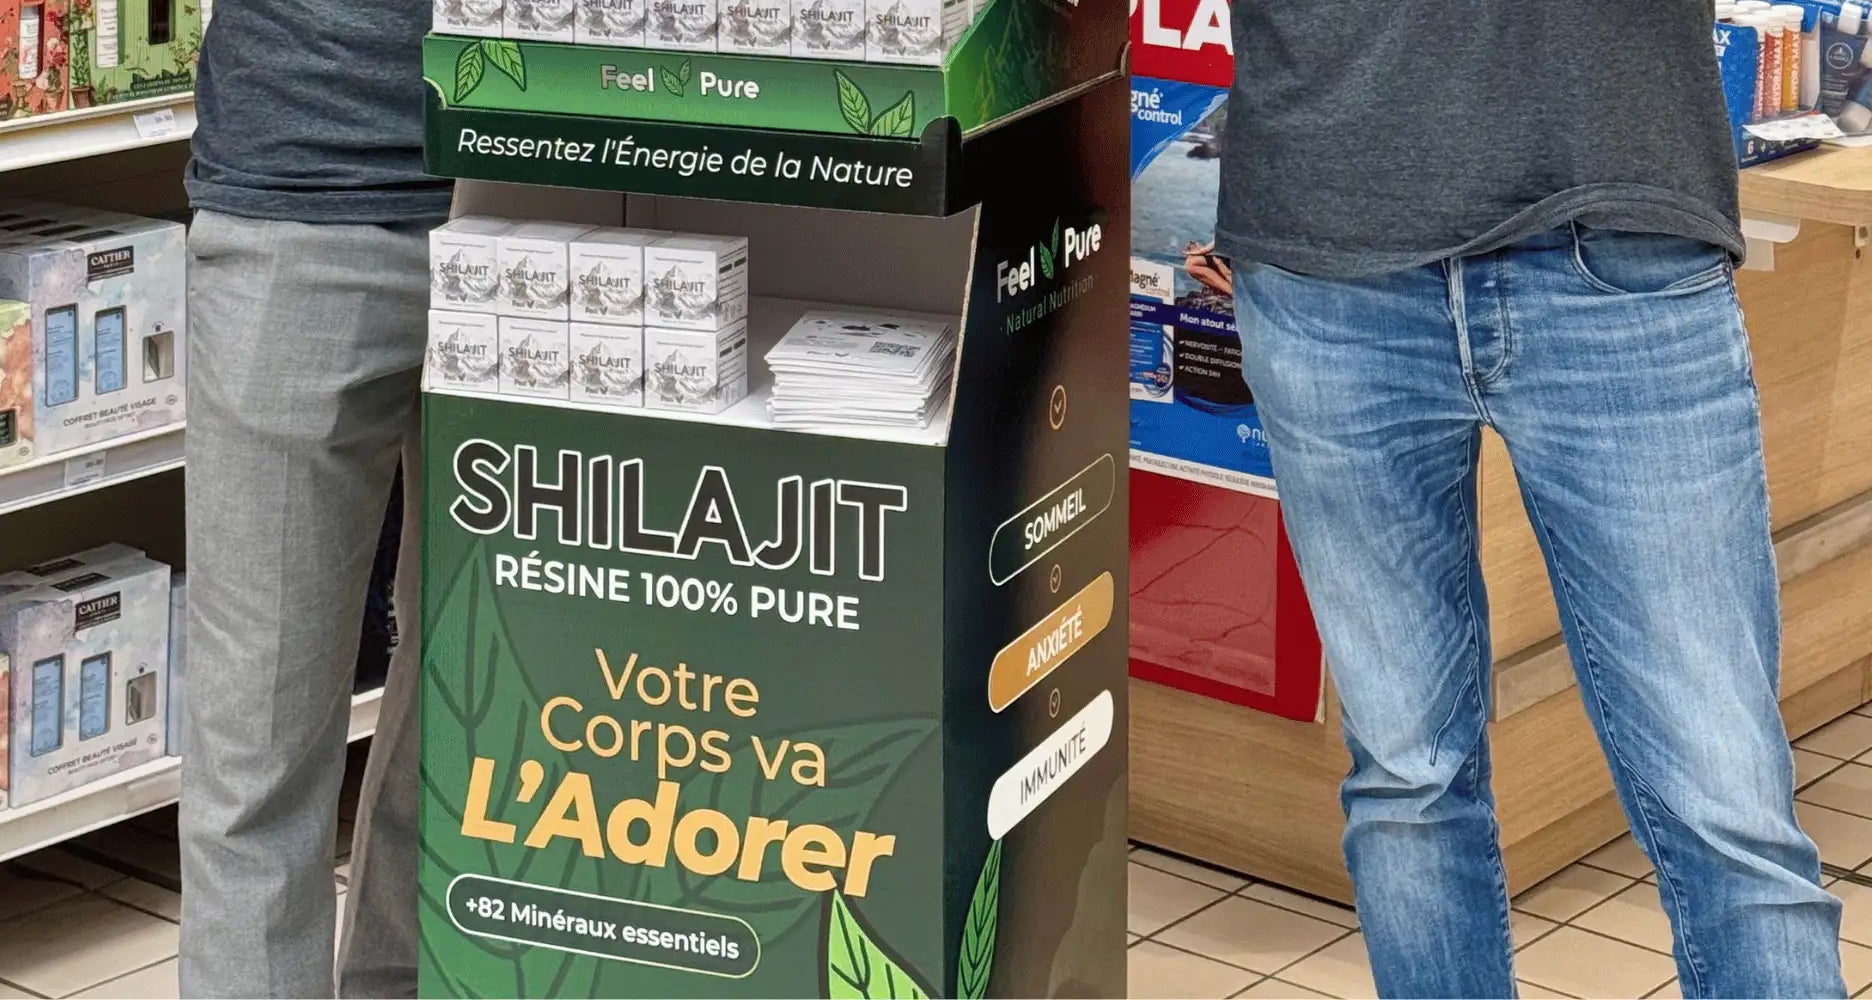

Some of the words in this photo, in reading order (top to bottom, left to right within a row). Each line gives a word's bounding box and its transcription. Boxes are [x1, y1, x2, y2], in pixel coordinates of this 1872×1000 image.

[653, 1, 706, 16] SHILAJIT
[727, 5, 780, 20] SHILAJIT
[800, 8, 854, 23] SHILAJIT
[875, 13, 931, 28] SHILAJIT
[601, 65, 655, 92] Feel
[700, 72, 760, 99] Pure
[1137, 110, 1183, 126] control
[457, 128, 594, 163] Ressentez
[601, 138, 723, 178] l'Énergie
[731, 149, 766, 176] de
[775, 151, 801, 179] la
[809, 155, 914, 188] Nature
[91, 250, 130, 268] CATTIER
[997, 245, 1035, 303] Feel
[1065, 223, 1101, 268] Pure
[440, 261, 489, 276] SHILAJIT
[505, 268, 556, 283] SHILAJIT
[579, 274, 630, 289] SHILAJIT
[653, 278, 705, 293] SHILAJIT
[1006, 294, 1047, 336] Natural
[1049, 274, 1094, 313] Nutrition
[1180, 313, 1200, 325] Mon
[1201, 319, 1224, 330] atout
[437, 341, 487, 356] SHILAJIT
[508, 346, 559, 362] SHILAJIT
[579, 354, 631, 369] SHILAJIT
[655, 362, 707, 377] SHILAJIT
[63, 411, 97, 427] COFFRET
[449, 438, 908, 582] SHILAJIT
[1024, 487, 1086, 550] SOMMEIL
[495, 550, 630, 602] RÉSINE
[642, 571, 738, 616] 100%
[751, 586, 860, 631] PURE
[1025, 603, 1083, 677] ANXIÉTÉ
[595, 648, 759, 717] Votre
[540, 696, 732, 779] Corps
[751, 735, 827, 787] va
[1020, 720, 1087, 806] IMMUNITÉ
[460, 756, 897, 898] L'Adorer
[466, 894, 506, 922] +82
[511, 901, 617, 941] Minéraux
[622, 925, 740, 960] essentiels
